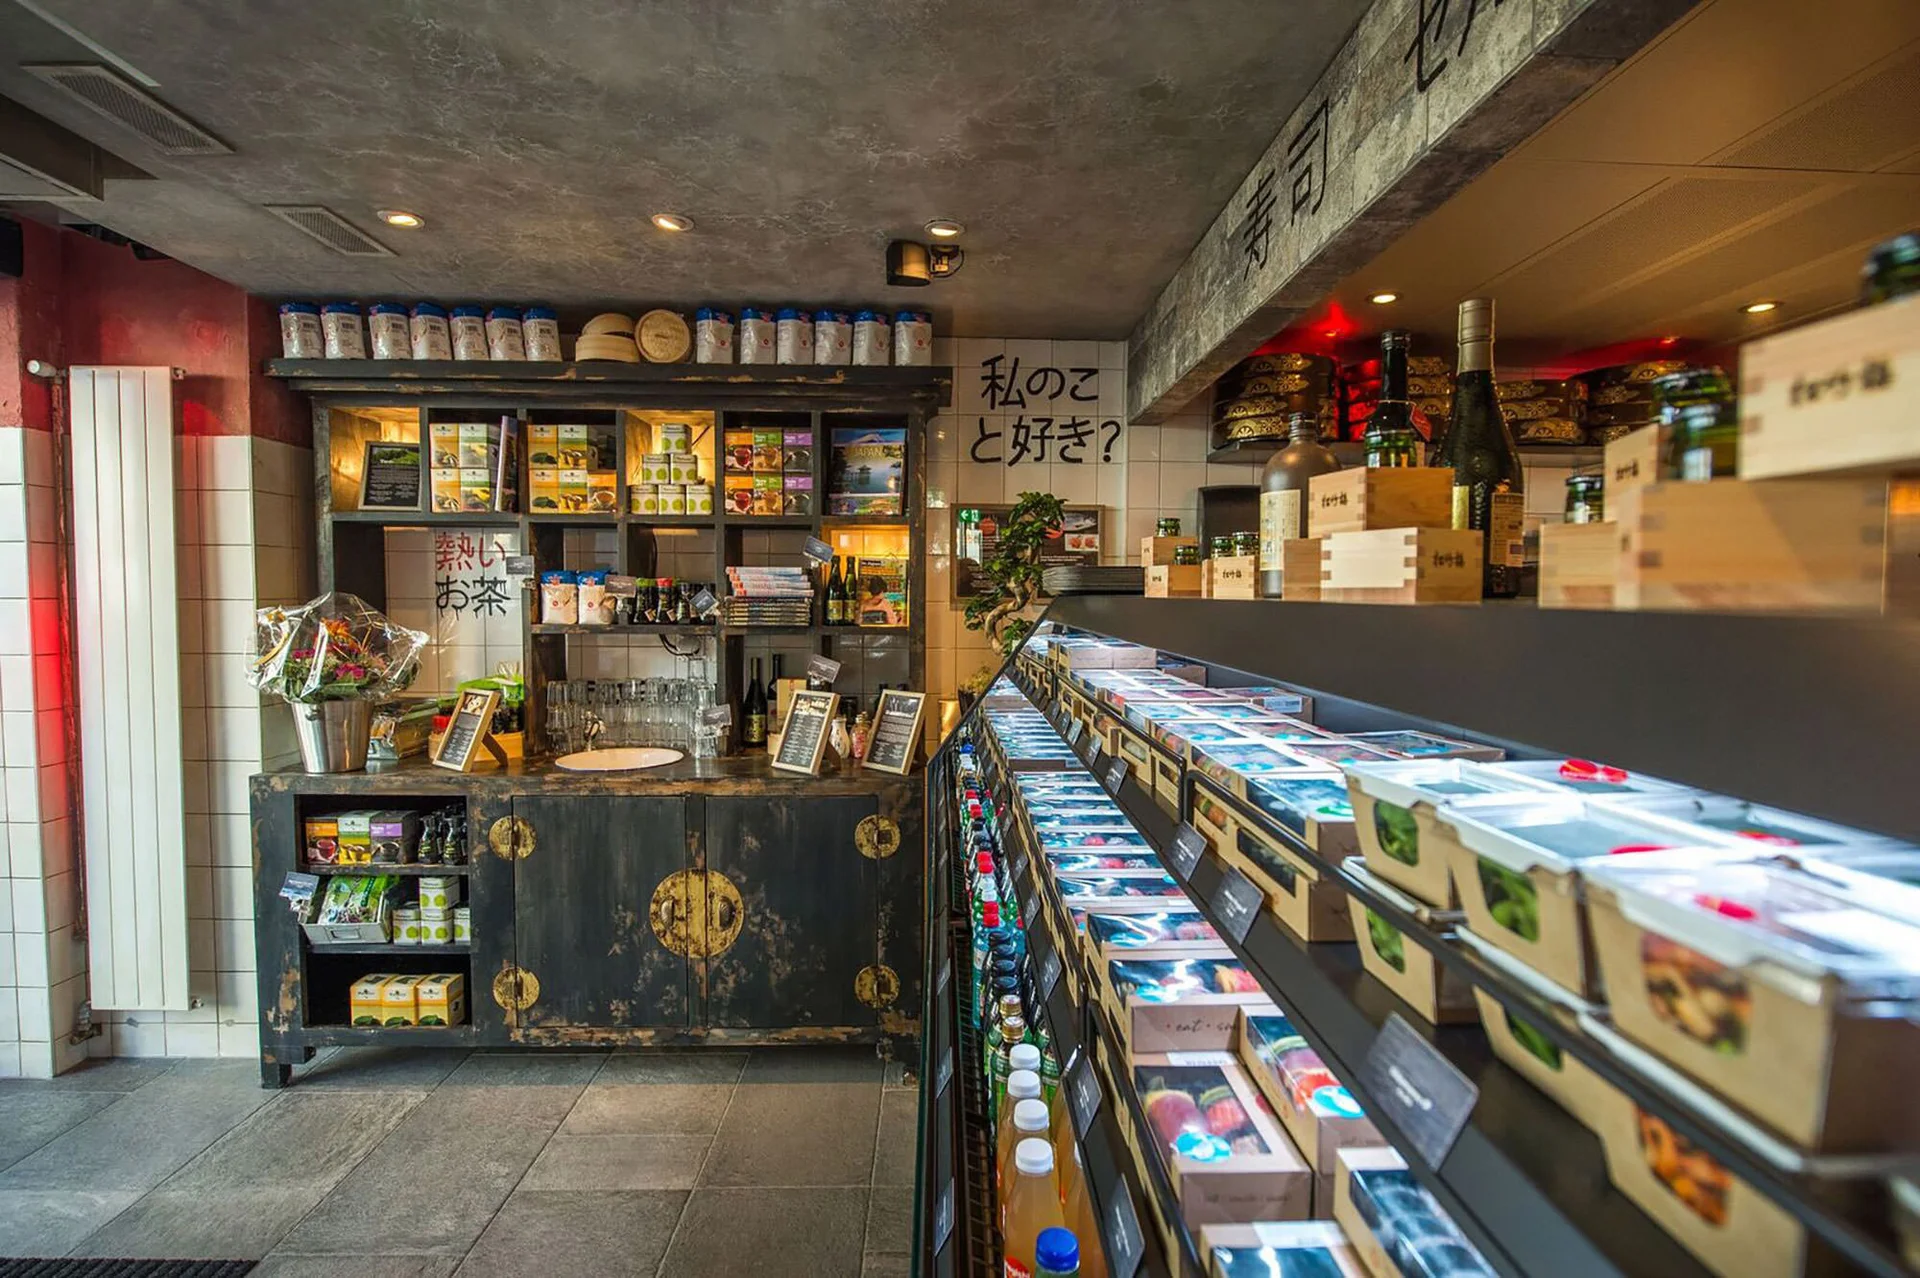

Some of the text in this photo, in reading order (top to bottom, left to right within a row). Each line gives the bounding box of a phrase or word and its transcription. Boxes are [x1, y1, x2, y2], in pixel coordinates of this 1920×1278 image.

[981, 354, 1099, 410] 私のこ
[970, 415, 1121, 467] と好き?
[436, 532, 506, 571] 熱い
[435, 575, 511, 620] お茶
